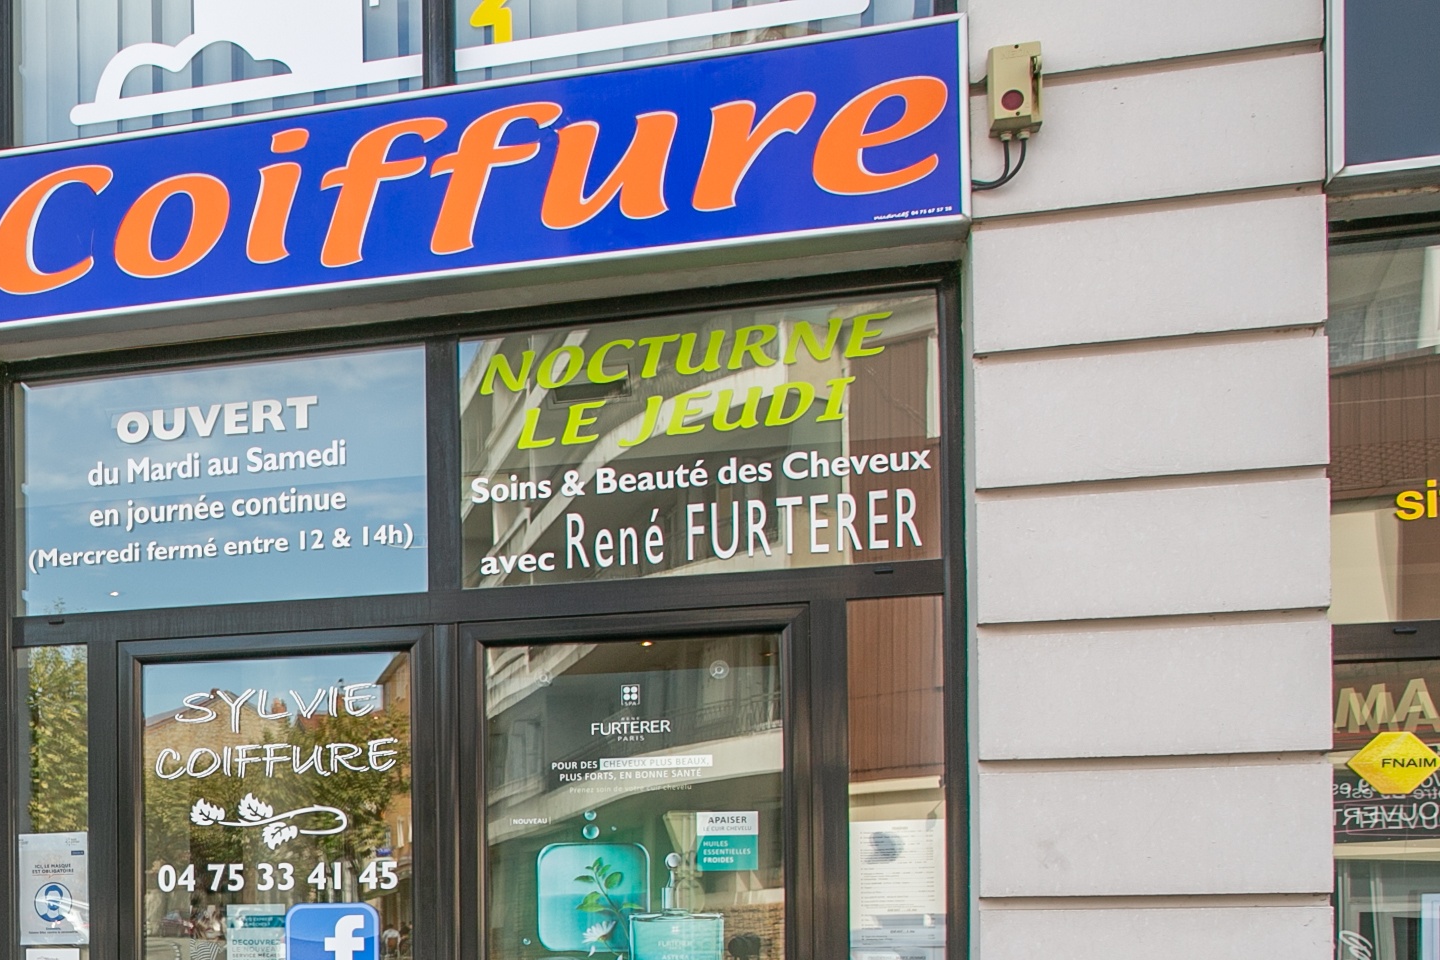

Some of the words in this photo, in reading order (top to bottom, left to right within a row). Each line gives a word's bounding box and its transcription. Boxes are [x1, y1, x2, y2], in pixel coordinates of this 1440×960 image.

[480, 311, 893, 396] NOCTURNE
[116, 396, 318, 444] OUVERT
[517, 401, 606, 450] LE
[618, 375, 857, 448] JEUDI
[88, 461, 119, 487] du
[127, 453, 201, 483] Mardi
[207, 455, 239, 477] au
[246, 439, 347, 473] Samedi
[471, 474, 552, 504] Soins
[561, 470, 586, 498] &
[596, 460, 709, 496] Beauté
[718, 456, 773, 486] des
[782, 449, 931, 480] Cheveux
[89, 505, 120, 528] en
[126, 495, 225, 532] journée
[231, 487, 347, 517] continue
[1396, 479, 1440, 521] si
[29, 543, 141, 574] (Mercredi
[147, 538, 218, 562] fermé
[224, 535, 289, 557] entre
[298, 528, 325, 551] 12
[332, 527, 352, 549] &
[362, 523, 414, 550] 14h)
[480, 551, 555, 576] avec
[566, 508, 665, 570] René
[686, 488, 923, 562] FURTERER
[174, 682, 378, 735] SYLVIE
[591, 720, 671, 736] FURTERER
[155, 737, 399, 781] COIFFURE
[552, 761, 578, 770] POUR
[581, 760, 598, 769] DES
[603, 760, 647, 768] CHEVEUX
[650, 758, 672, 767] PLUS
[560, 773, 582, 782] PLUS
[585, 771, 617, 781] FORTS,
[620, 771, 633, 780] EN
[635, 770, 668, 779] BONNE
[672, 768, 702, 778] SANTÉ
[1381, 758, 1437, 768] FNAIM
[570, 786, 594, 794] Prenez
[512, 818, 548, 826] NOUVEAU
[708, 816, 747, 824] APAISER
[158, 863, 196, 892] 04
[207, 863, 245, 892] 75
[256, 863, 295, 891] 33
[307, 862, 342, 890] 41
[359, 861, 399, 889] 45
[703, 856, 734, 864] FROIDES
